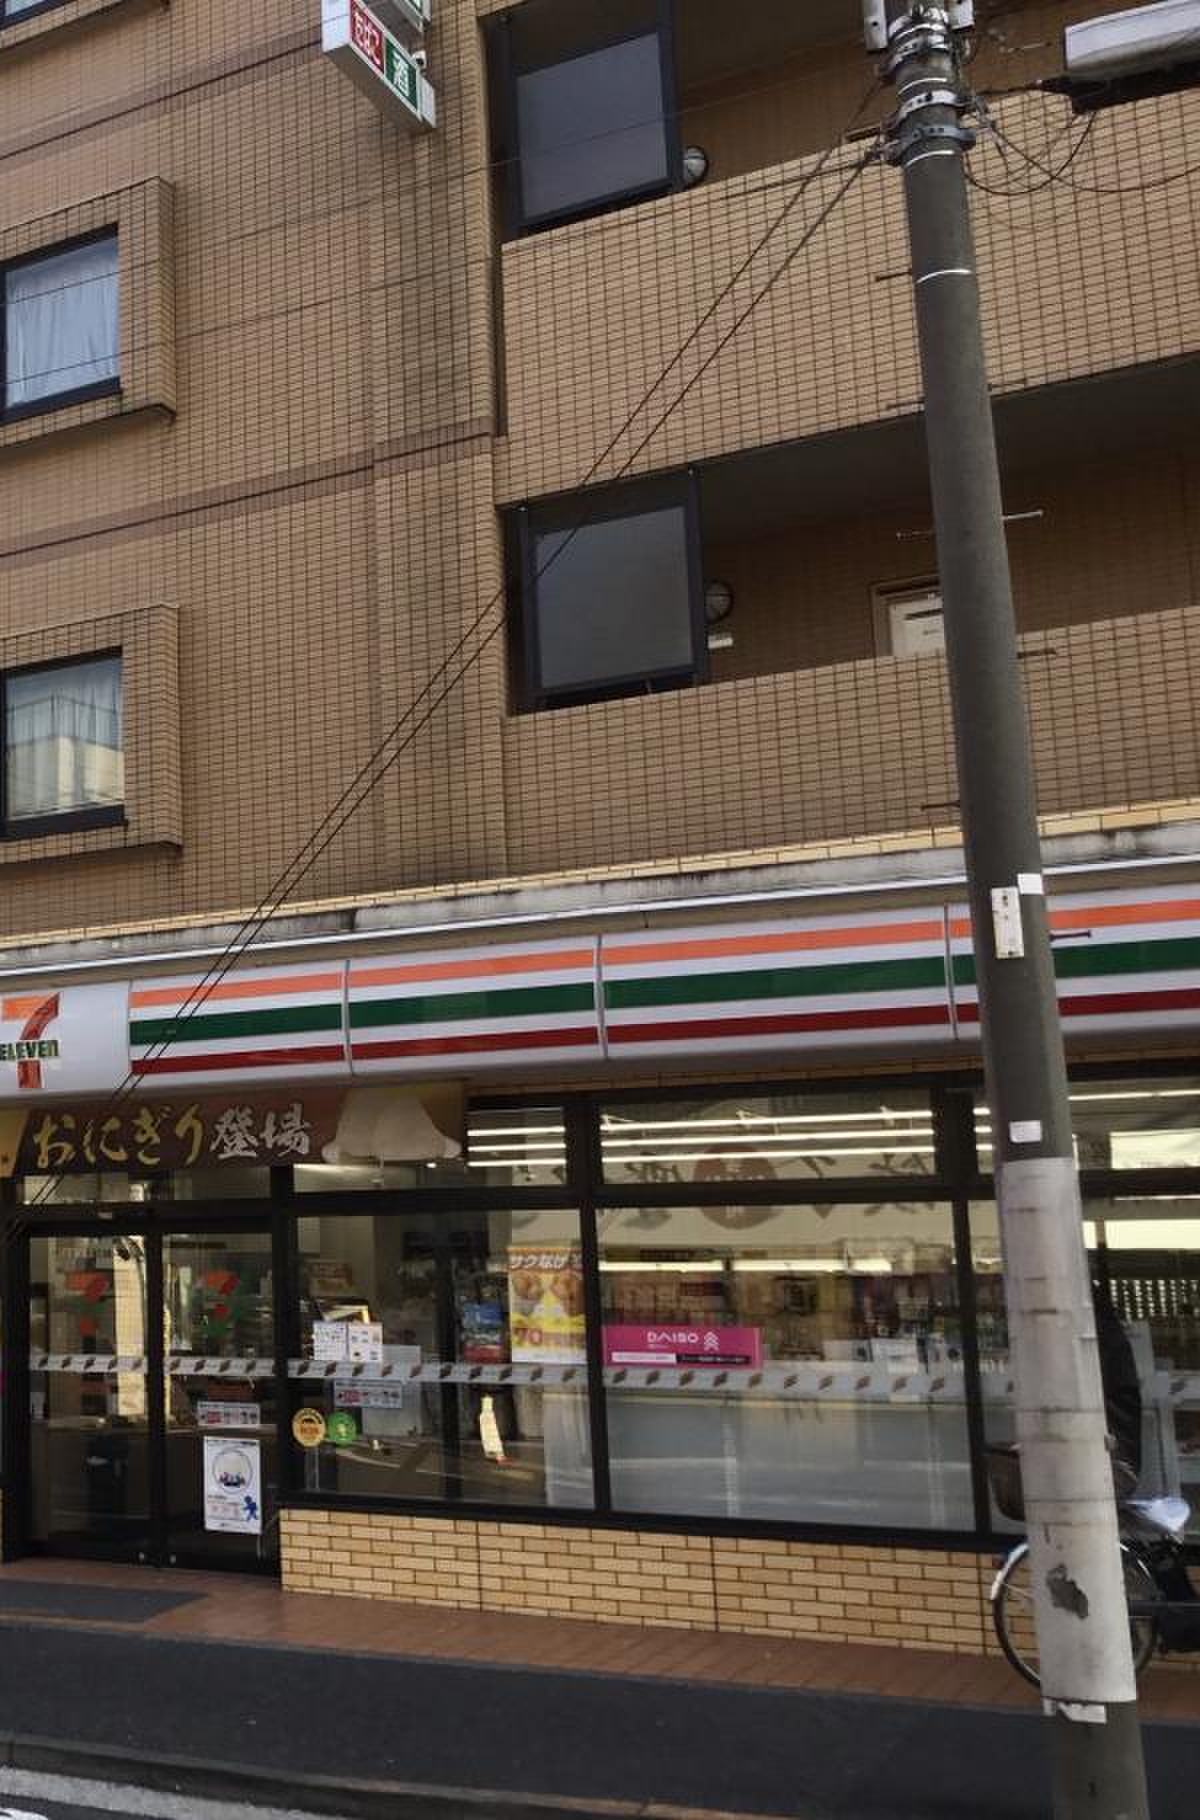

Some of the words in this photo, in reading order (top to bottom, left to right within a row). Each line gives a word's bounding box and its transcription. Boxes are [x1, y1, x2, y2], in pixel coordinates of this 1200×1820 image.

[1, 993, 59, 1089] 7
[32, 1101, 311, 1168] おにぎり登場
